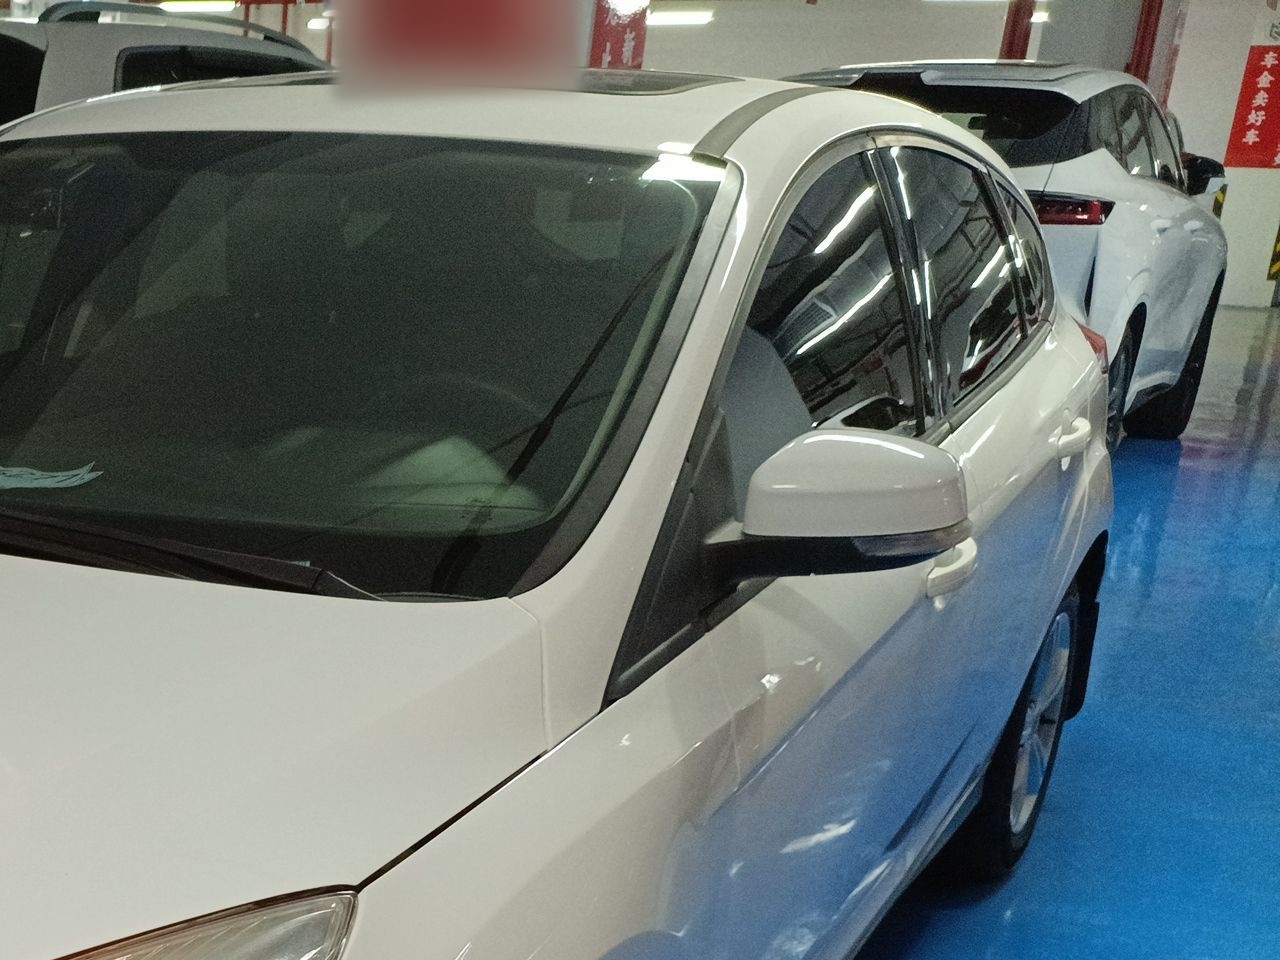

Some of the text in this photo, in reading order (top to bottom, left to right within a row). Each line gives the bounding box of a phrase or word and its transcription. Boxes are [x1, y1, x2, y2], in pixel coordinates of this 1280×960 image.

[1242, 51, 1279, 145] 车金卖好车
